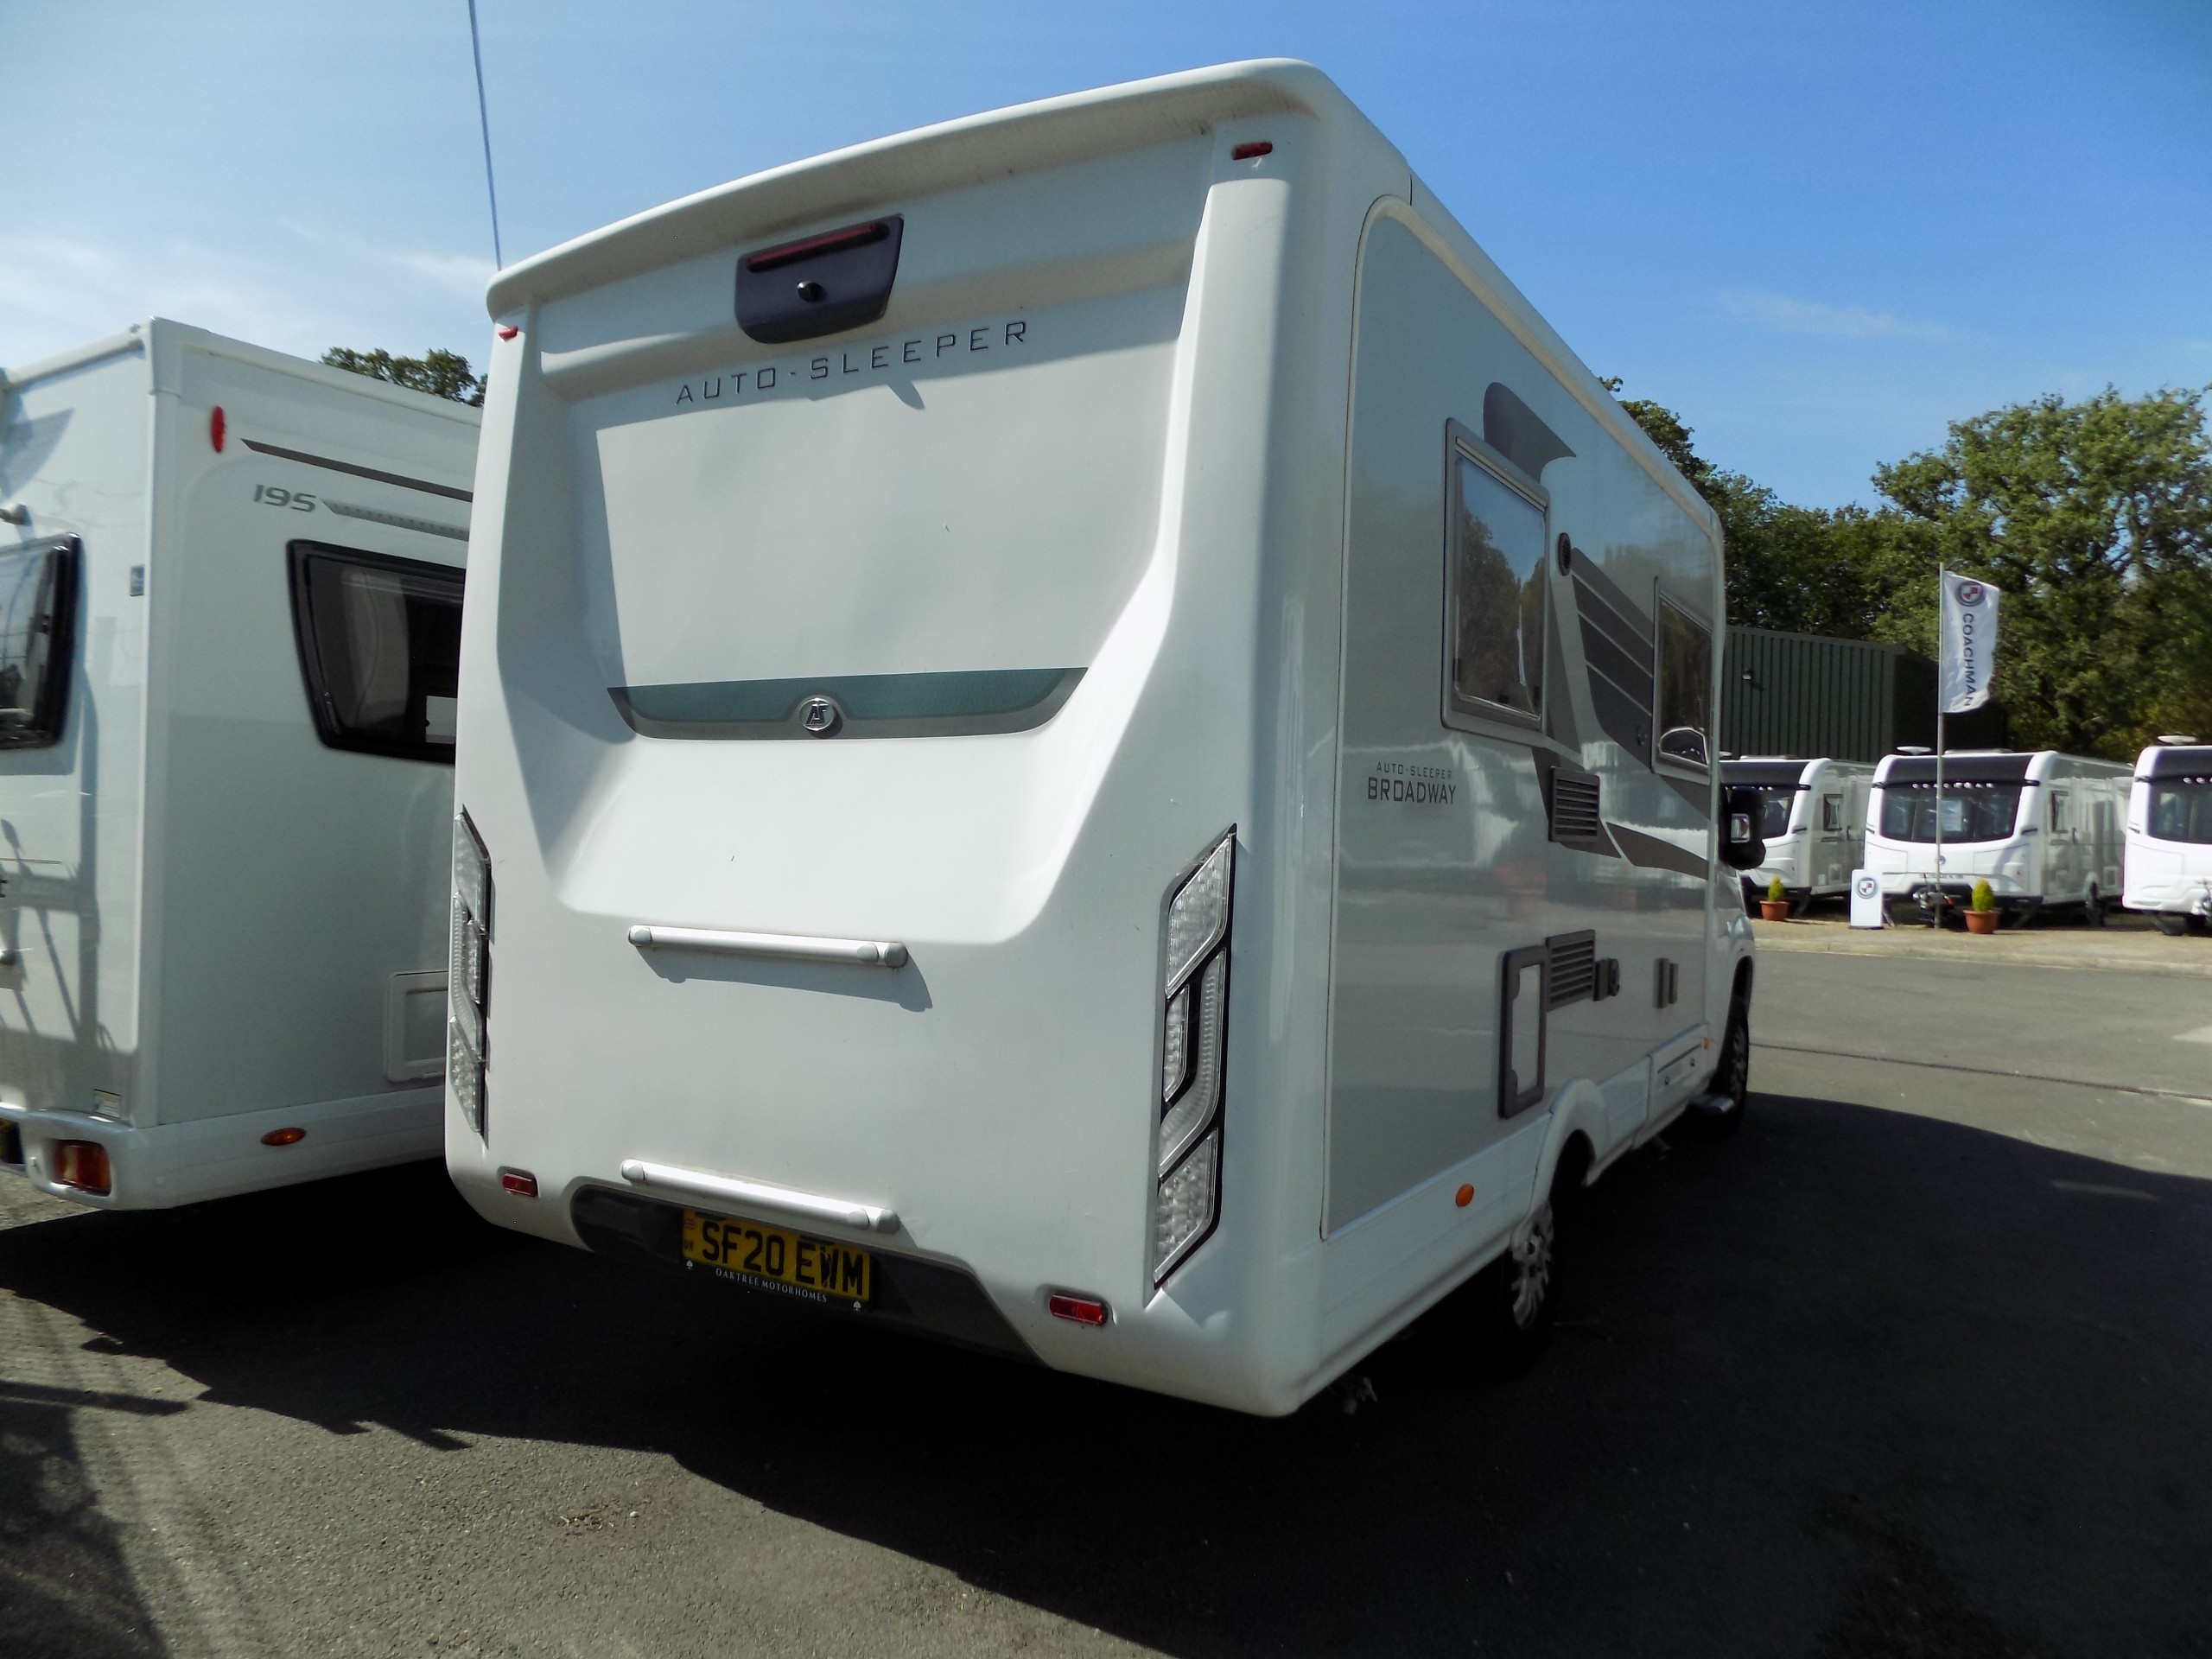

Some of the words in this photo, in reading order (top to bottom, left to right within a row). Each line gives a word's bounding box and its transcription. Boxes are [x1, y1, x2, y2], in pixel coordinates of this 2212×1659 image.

[253, 484, 316, 512] 195
[1962, 613, 1976, 706] COACHMAN
[1368, 777, 1456, 804] BROADWAY
[702, 1219, 785, 1277] SF20
[795, 1240, 863, 1296] EWM
[715, 1268, 760, 1287] OAKTREE
[761, 1280, 828, 1303] MOTORHOMES
